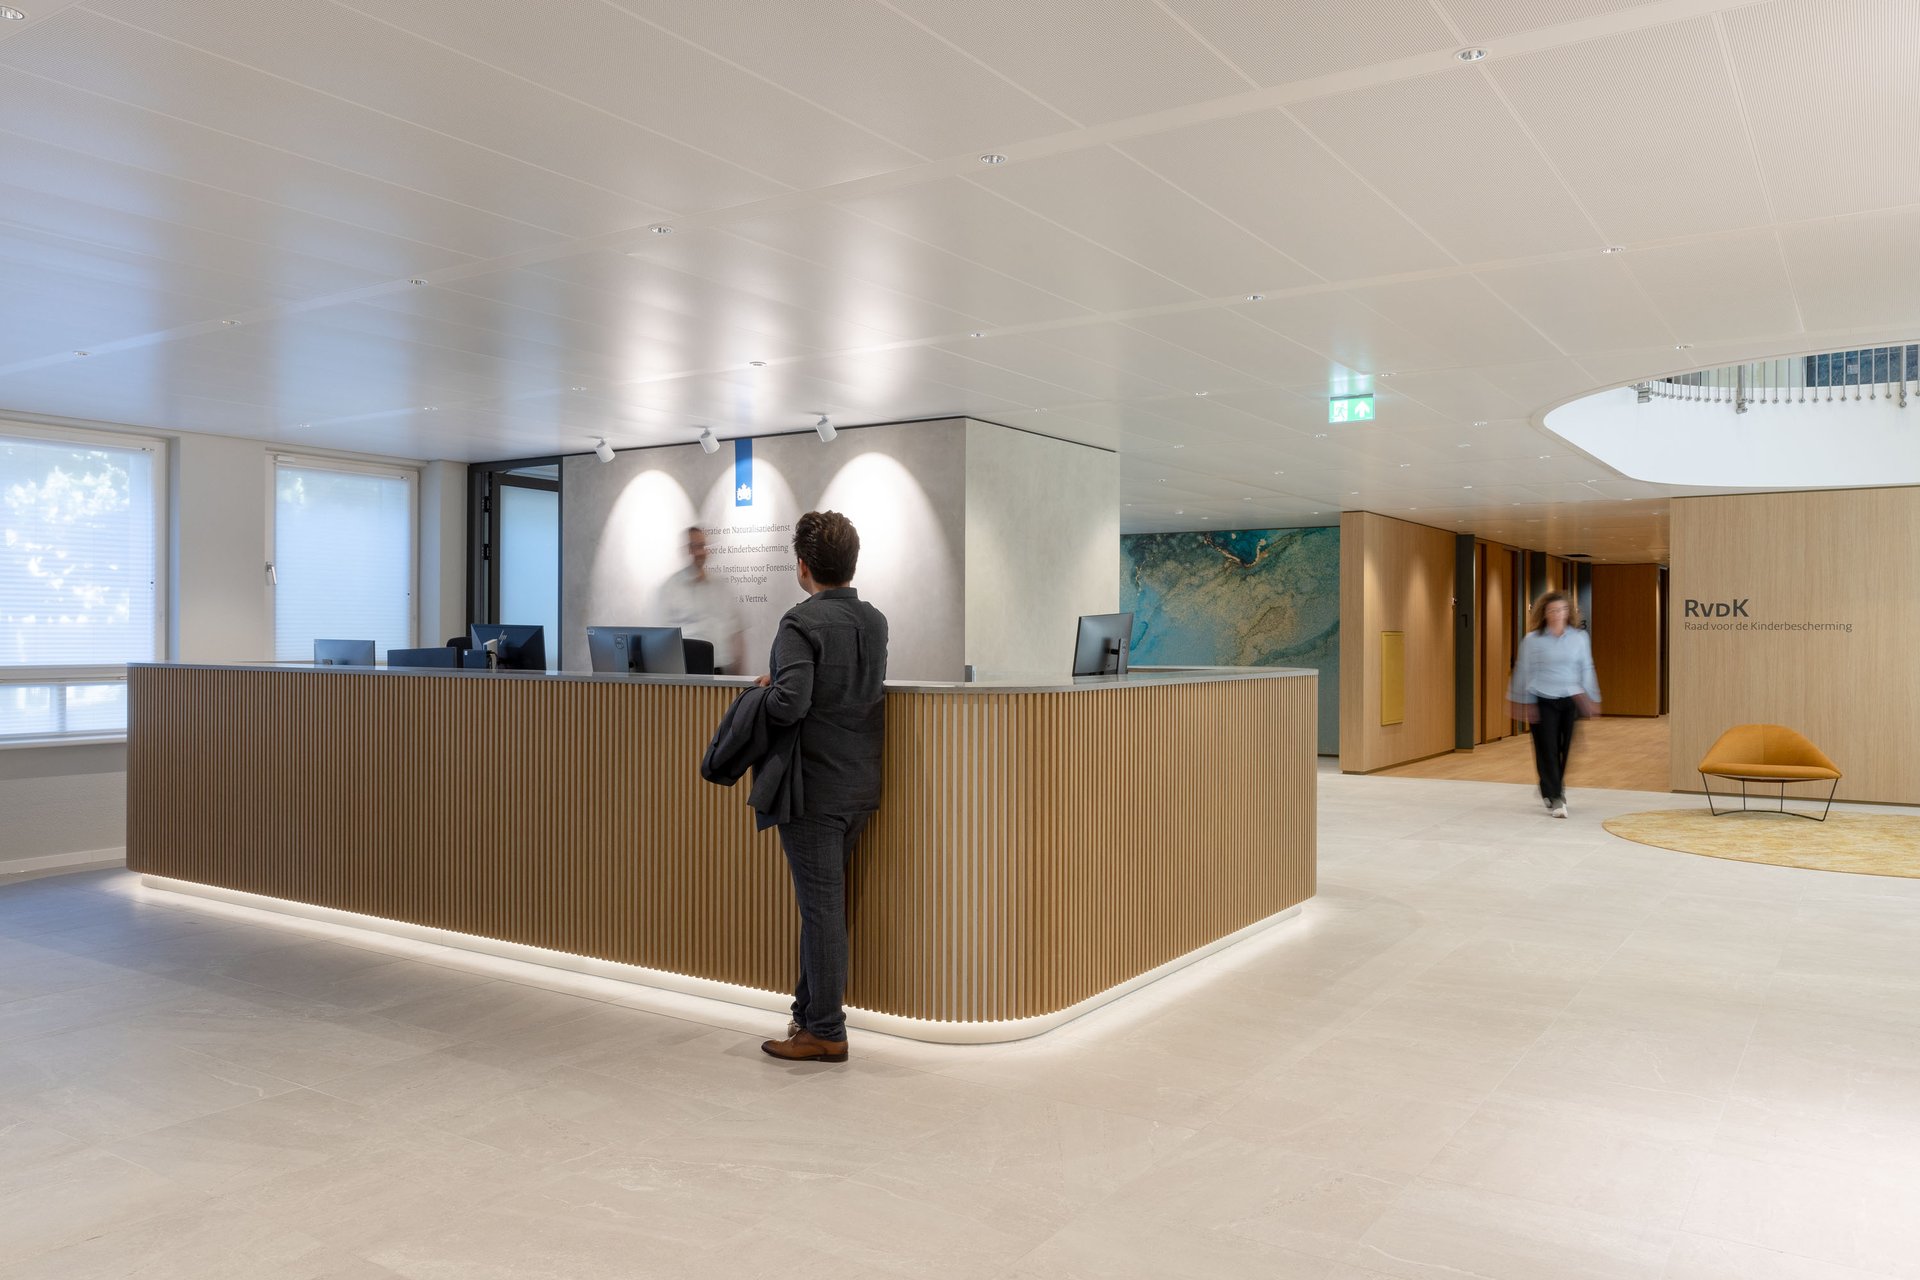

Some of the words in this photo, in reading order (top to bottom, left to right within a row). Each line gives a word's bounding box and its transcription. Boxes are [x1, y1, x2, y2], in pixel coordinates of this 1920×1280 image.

[702, 527, 722, 536] igratie
[732, 524, 791, 534] Naturalisatiedienst
[718, 546, 727, 554] de
[727, 544, 789, 554] Kinderbescherming
[723, 564, 750, 573] Instituut
[766, 563, 796, 572] Forensisc
[730, 575, 768, 585] Psychologie
[745, 594, 768, 602] Vertrek
[1684, 621, 1709, 631] Raad
[1711, 623, 1735, 631] voor
[1735, 621, 1749, 631] de
[1750, 621, 1853, 633] Kinderbescherming
